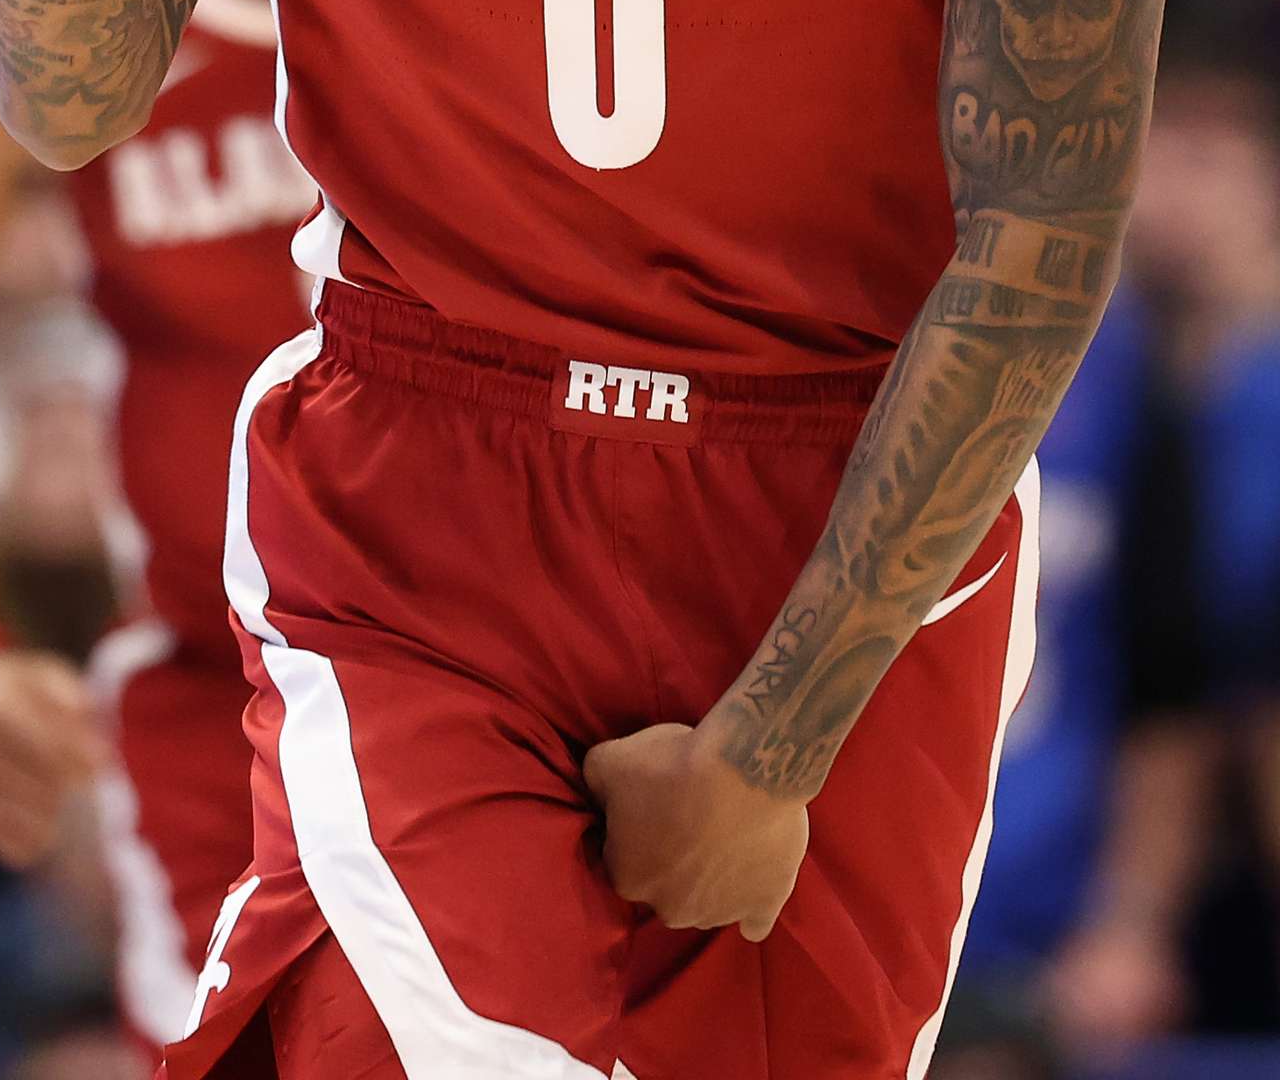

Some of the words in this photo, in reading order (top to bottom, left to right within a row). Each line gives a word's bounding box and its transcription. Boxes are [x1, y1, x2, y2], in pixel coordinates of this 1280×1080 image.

[951, 90, 1038, 170] BAD
[564, 359, 691, 424] RTR
[743, 604, 817, 717] SCARY
